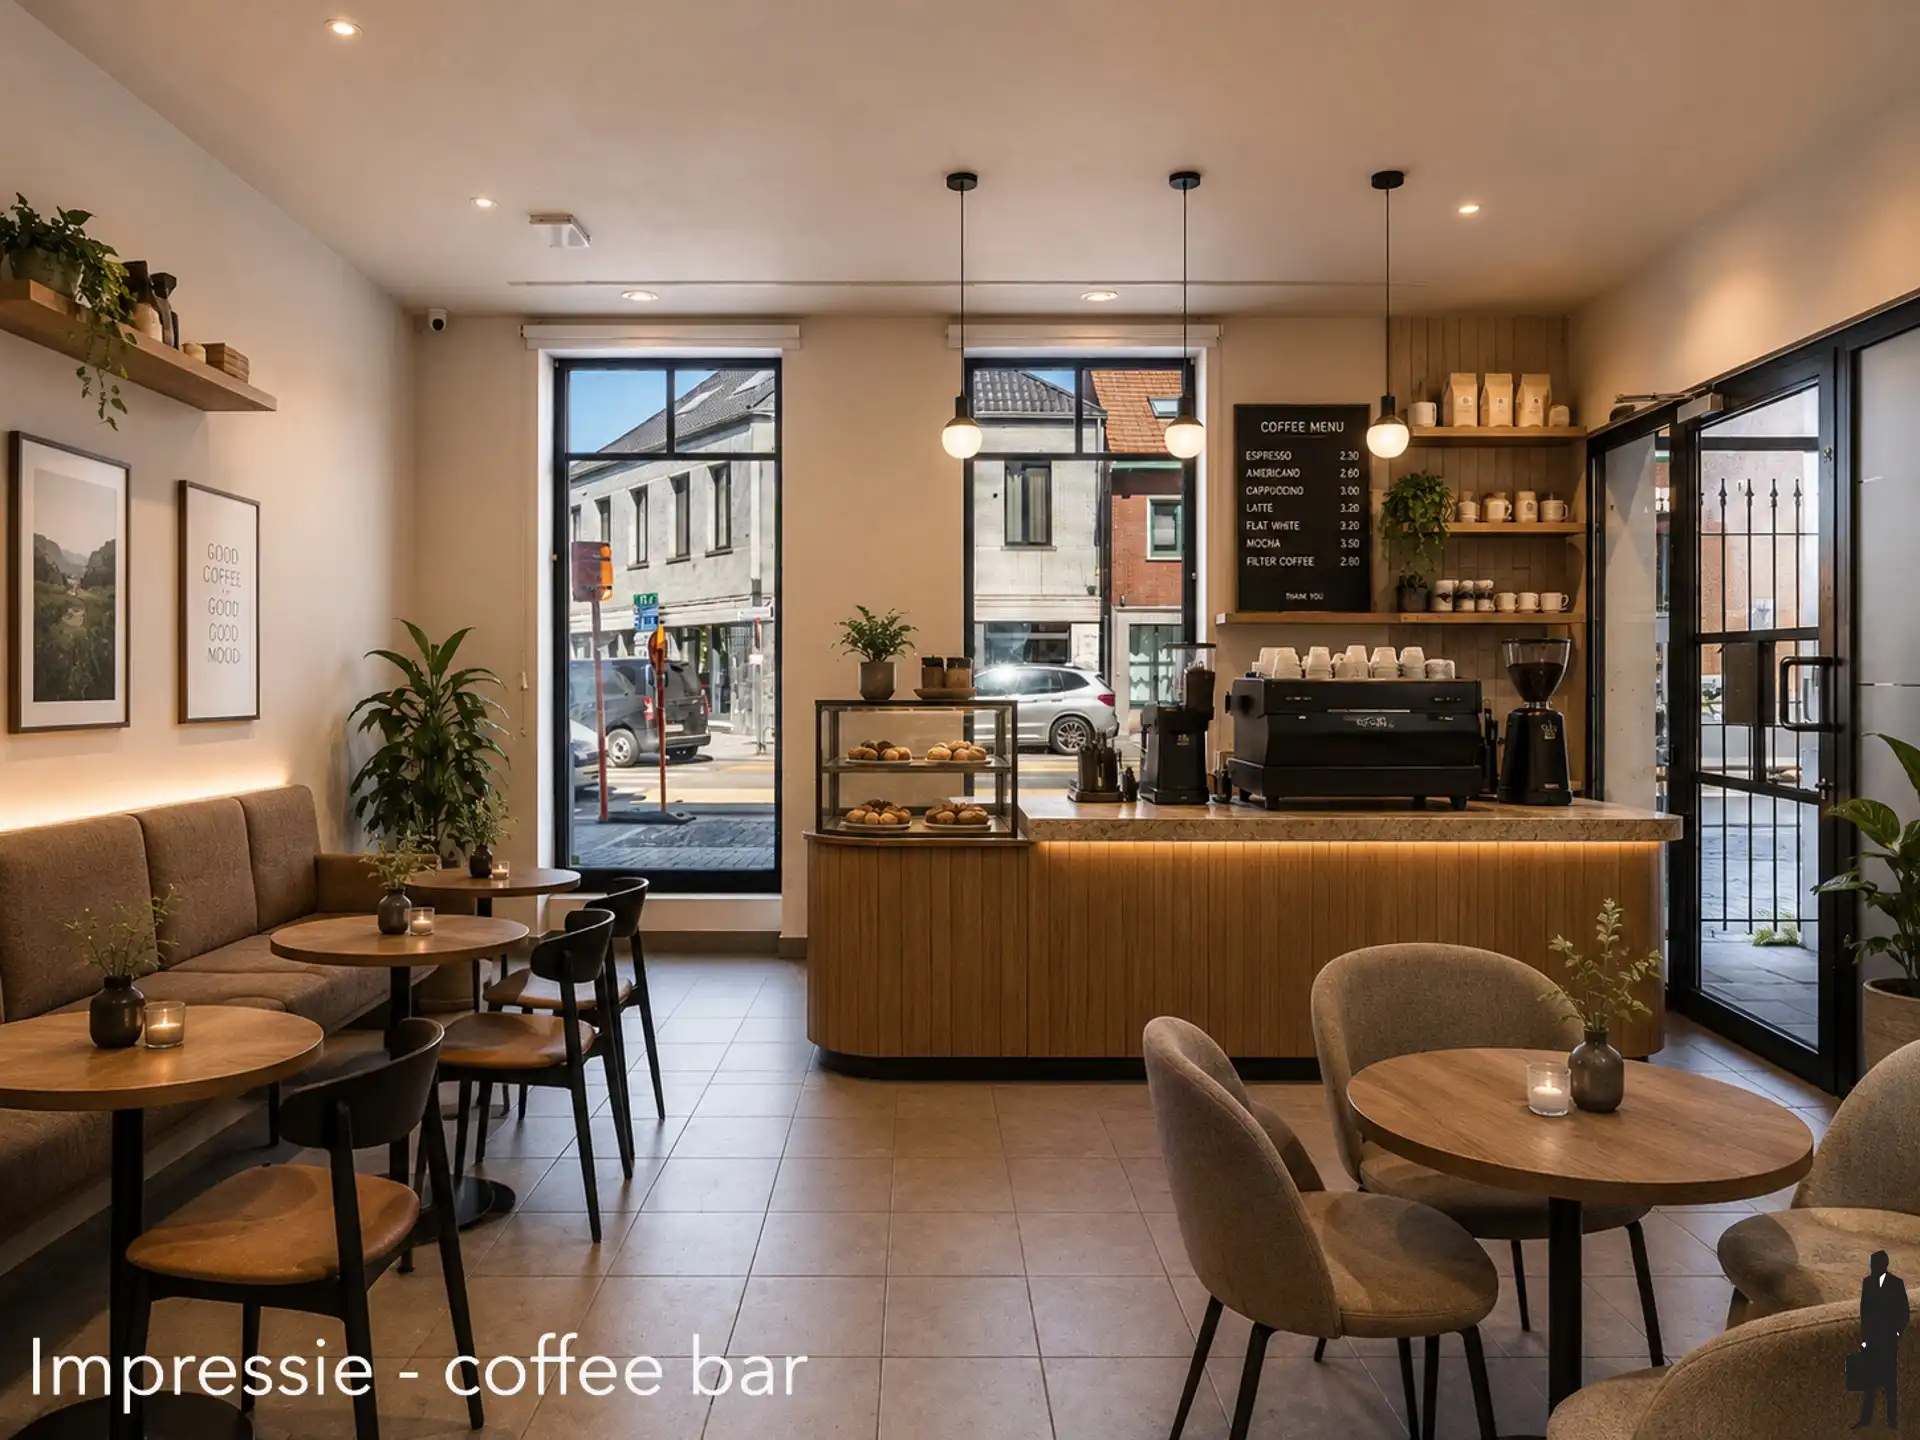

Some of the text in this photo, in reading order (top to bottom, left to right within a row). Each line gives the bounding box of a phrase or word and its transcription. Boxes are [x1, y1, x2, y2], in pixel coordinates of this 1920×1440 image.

[1260, 421, 1345, 433] COFFEE MENU
[1246, 450, 1293, 461] ESPRESSO
[1246, 467, 1301, 478] AMERICANO
[1246, 503, 1274, 513] LATTE
[1246, 520, 1269, 531] FLAT
[1271, 520, 1301, 531] WHITE
[1246, 538, 1281, 549] MOCHA
[207, 542, 240, 565] GOOD
[1246, 556, 1277, 567] FILTER
[1278, 556, 1316, 567] COFFEE
[202, 564, 242, 588] COFFEE
[207, 597, 240, 617] GOOD
[208, 622, 240, 642] GOOD
[207, 646, 241, 664] MOOD
